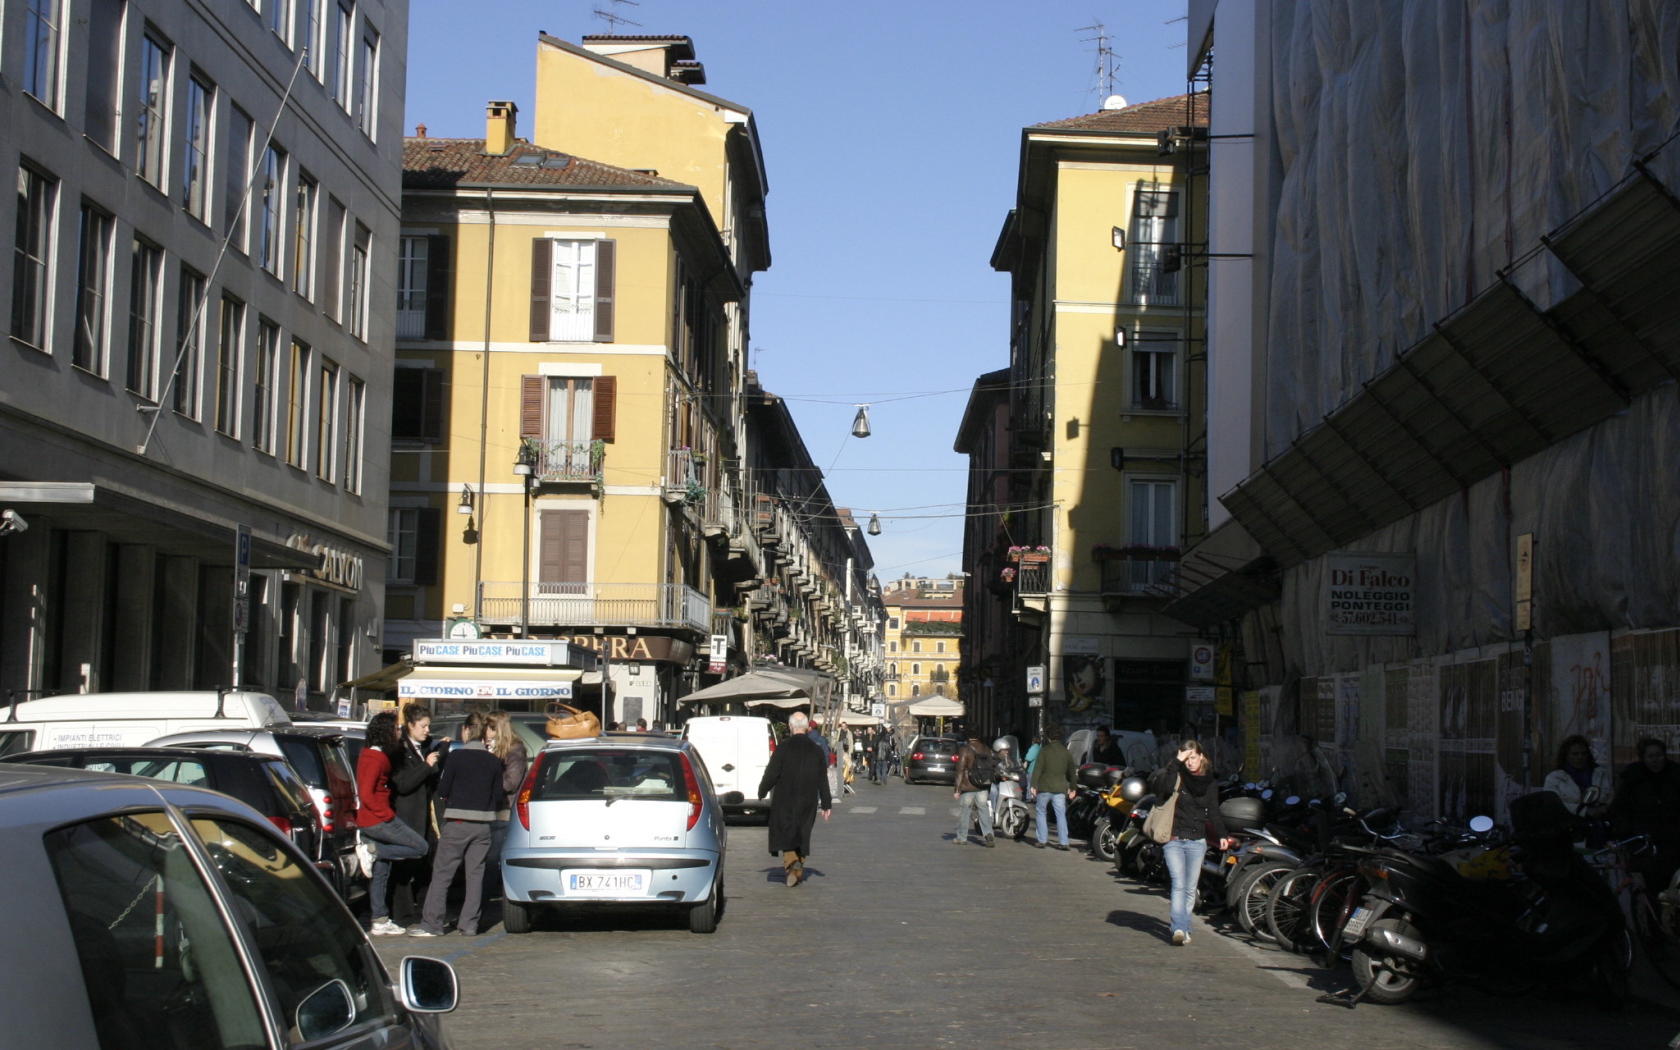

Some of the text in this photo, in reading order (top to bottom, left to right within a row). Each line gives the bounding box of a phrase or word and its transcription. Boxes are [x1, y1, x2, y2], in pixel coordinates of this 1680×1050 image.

[1331, 569, 1411, 588] Di Falco
[1331, 590, 1411, 601] NOLEGGIO
[1331, 601, 1410, 611] PONTEGGI
[400, 686, 416, 695] IL
[418, 686, 474, 696] GIORNO
[496, 687, 512, 696] IL
[514, 687, 571, 697] GIORNO
[58, 733, 122, 742] IMPIANTI ELETTRICI
[578, 876, 634, 889] BX 741HC
